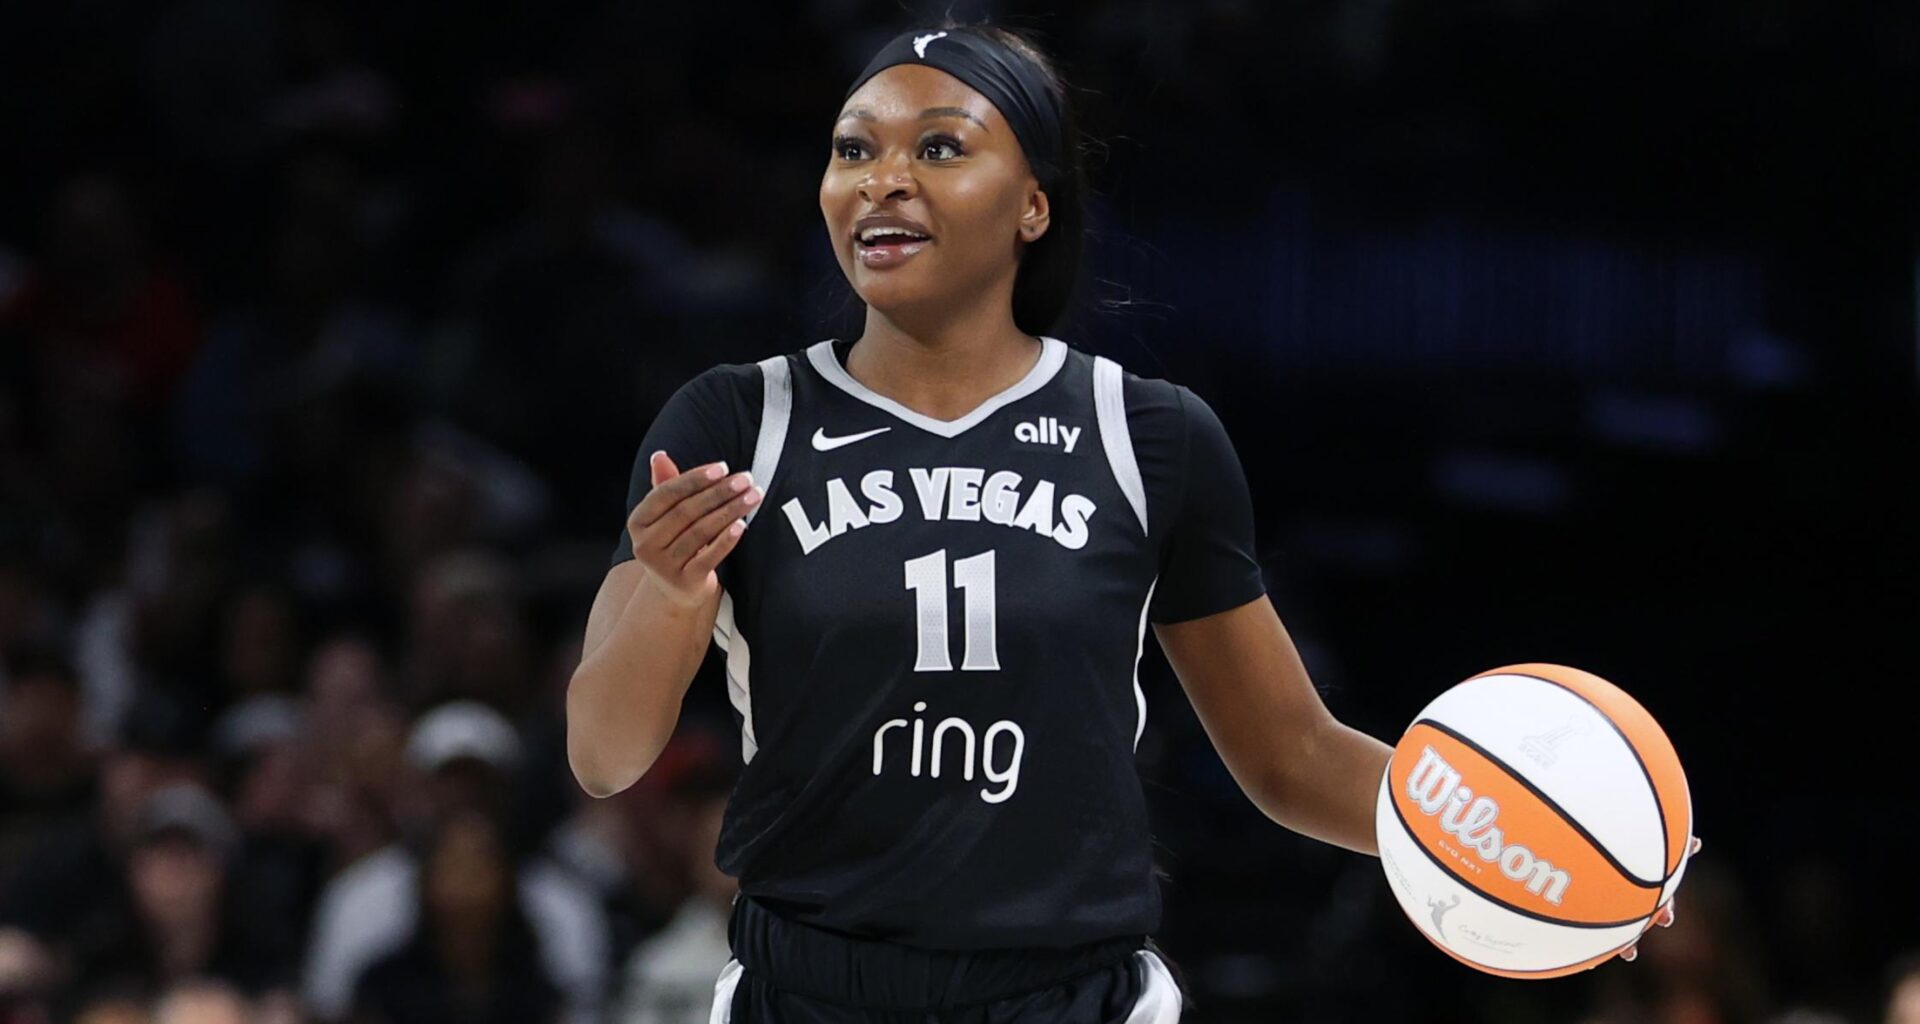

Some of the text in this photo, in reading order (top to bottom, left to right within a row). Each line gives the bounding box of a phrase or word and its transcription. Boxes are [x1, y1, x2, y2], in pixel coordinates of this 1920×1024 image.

[1014, 416, 1081, 453] ally
[781, 466, 1097, 555] LAS VEGAS
[904, 548, 1001, 672] 11
[872, 701, 1025, 804] ring
[1405, 744, 1572, 906] Wilson
